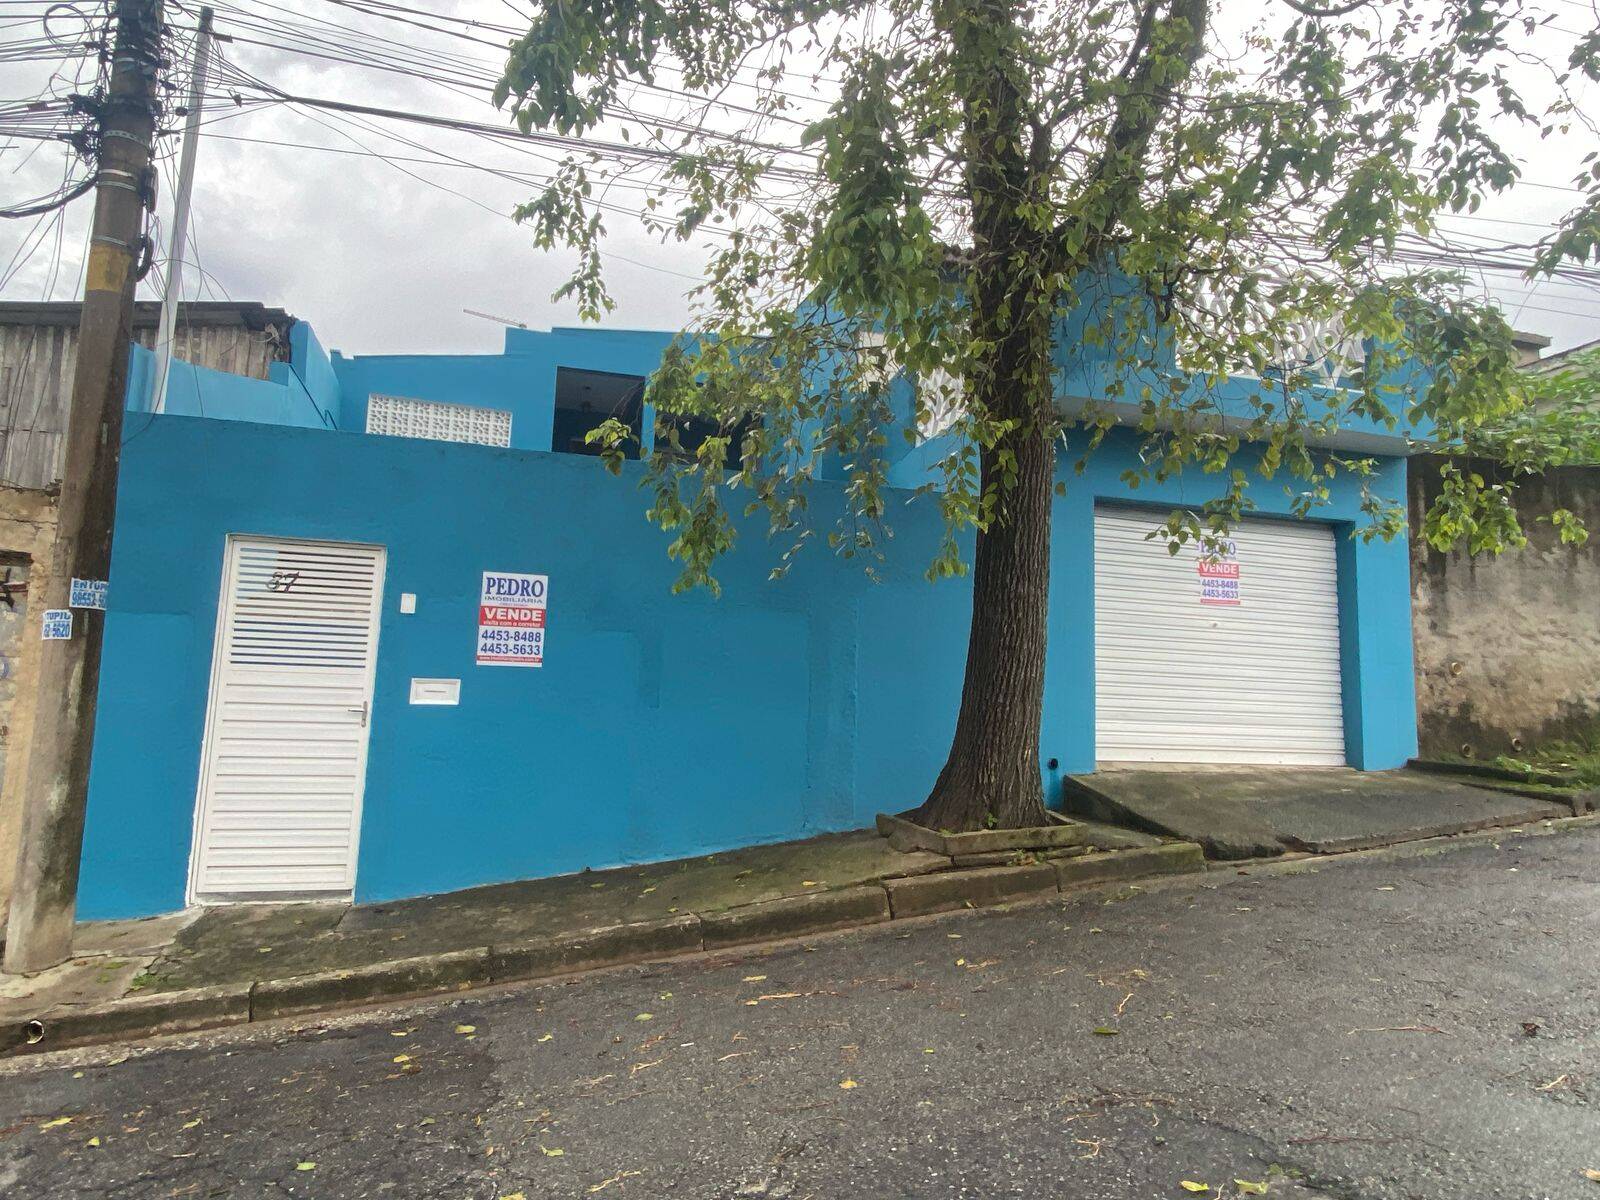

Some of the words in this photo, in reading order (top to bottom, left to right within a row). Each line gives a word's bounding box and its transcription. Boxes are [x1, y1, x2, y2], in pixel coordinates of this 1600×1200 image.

[1202, 563, 1237, 575] VENDE
[485, 577, 544, 597] PEDRO
[1202, 579, 1239, 589] 4453-8488
[1202, 589, 1239, 599] 4453-5633
[484, 607, 543, 621] VENDE
[481, 630, 541, 642] 4453-8488
[480, 643, 541, 656] 4453-5633
